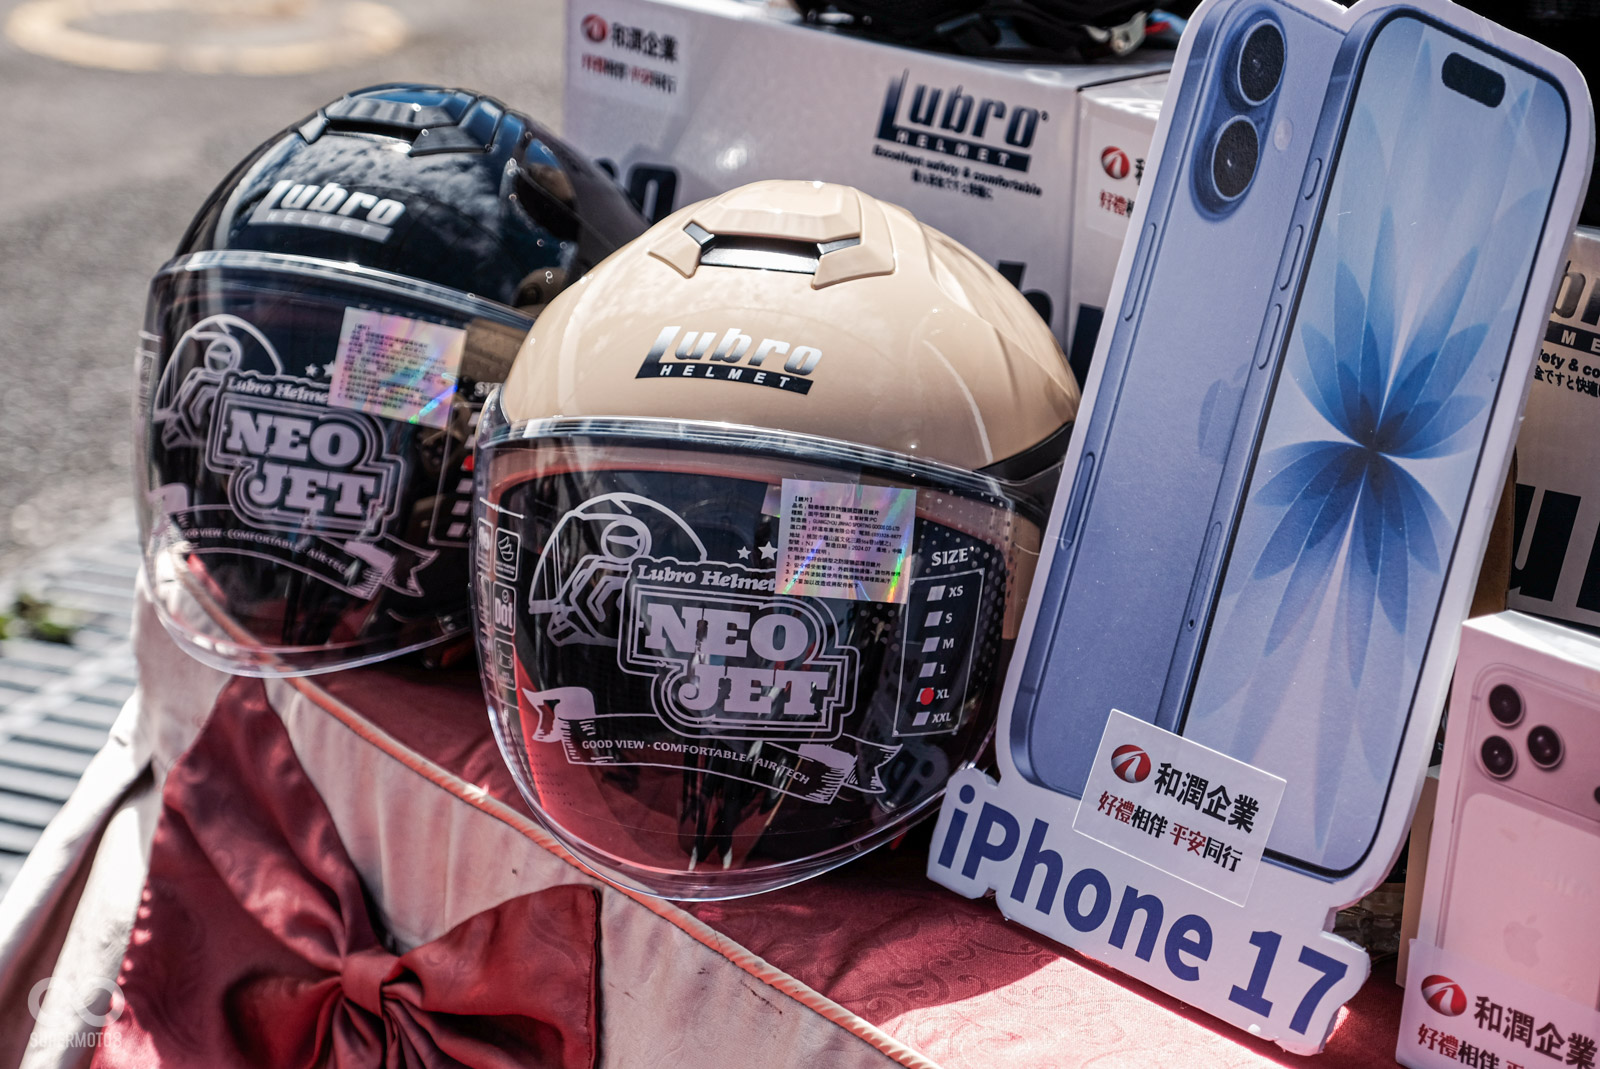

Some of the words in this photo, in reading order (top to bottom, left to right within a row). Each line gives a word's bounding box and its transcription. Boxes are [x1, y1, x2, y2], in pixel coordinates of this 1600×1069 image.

[877, 69, 1039, 148] Lubro
[896, 130, 1009, 167] HELMET
[249, 180, 406, 226] Lubro
[266, 210, 370, 235] HELMET
[636, 326, 823, 379] Lubro
[1540, 349, 1565, 369] ety
[1568, 358, 1578, 372] &
[227, 376, 272, 397] Lubro
[273, 383, 328, 405] Helme
[659, 365, 790, 388] HELMET
[225, 409, 361, 466] NEO
[248, 463, 378, 517] JET
[931, 548, 968, 566] SIZE
[637, 565, 696, 584] Lubro
[948, 585, 964, 598] XS
[644, 602, 808, 661] NEO
[945, 613, 953, 624] S
[942, 637, 954, 649] M
[940, 664, 947, 674] L
[678, 663, 829, 715] JET
[936, 688, 950, 699] XL
[931, 712, 951, 723] XXL
[582, 740, 613, 749] GOOD
[615, 740, 645, 749] VIEW
[653, 741, 747, 762] COMFORTABLE
[1154, 763, 1259, 833] 和潤企業
[1097, 791, 1168, 838] 好禮相伴
[1169, 822, 1243, 872] 平安同行
[937, 784, 1214, 982] iPhone
[1228, 930, 1349, 1036] 17
[1474, 996, 1598, 1069] 和潤企業
